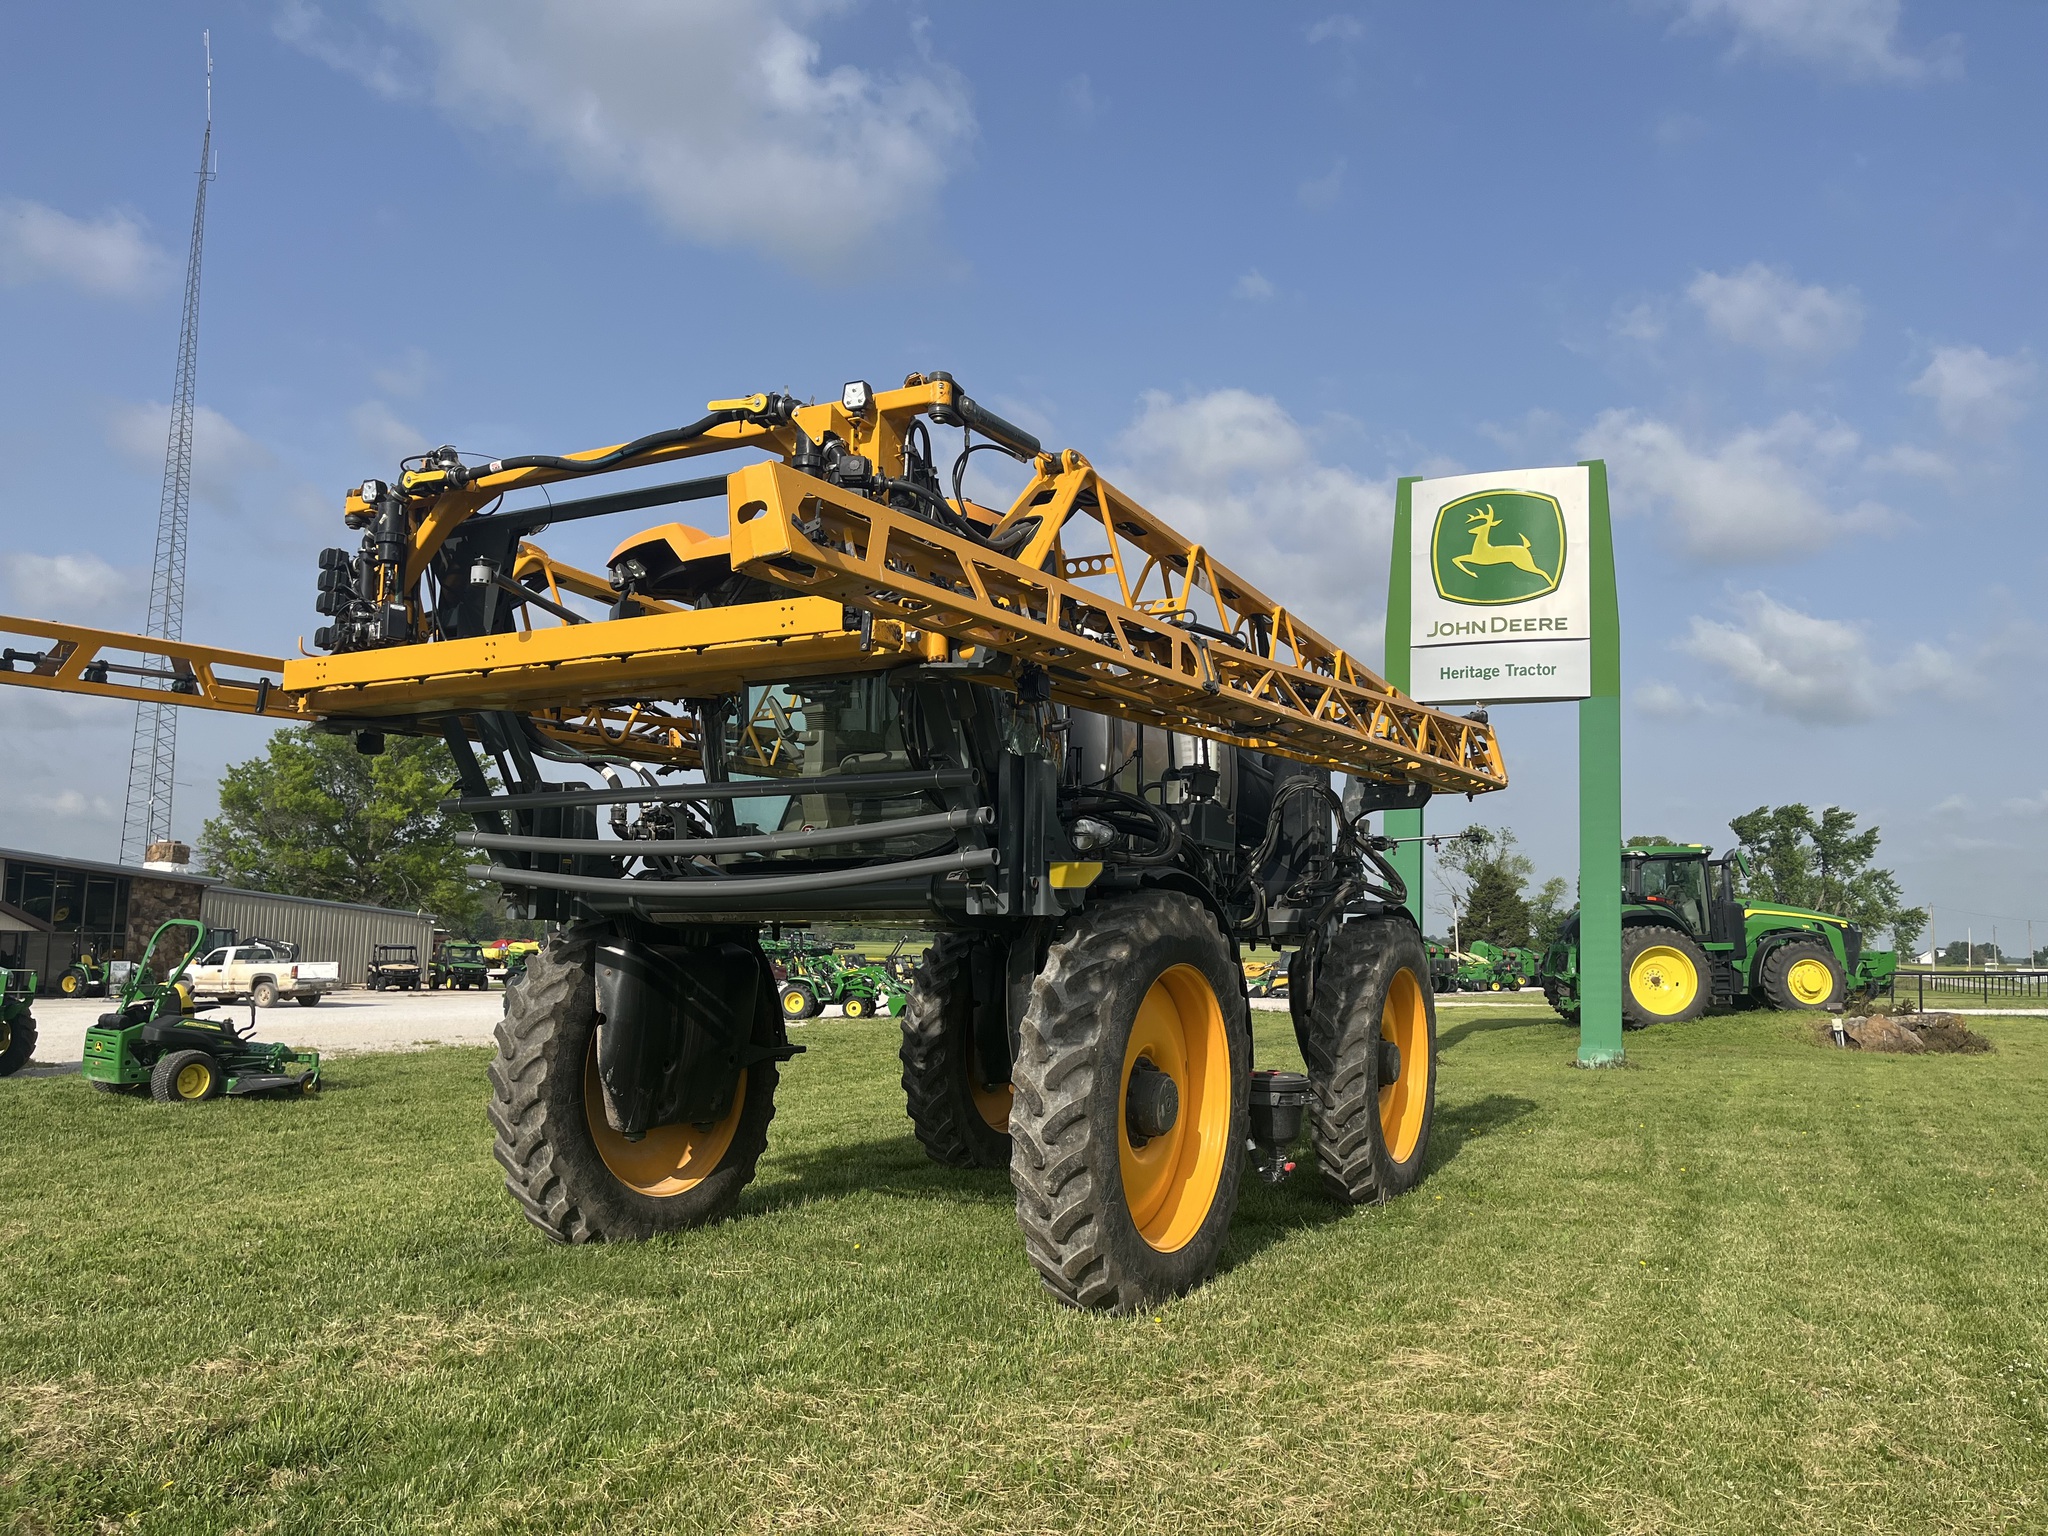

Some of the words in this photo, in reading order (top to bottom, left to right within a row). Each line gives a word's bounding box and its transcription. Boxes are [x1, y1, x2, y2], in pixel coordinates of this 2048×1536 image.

[1426, 621, 1486, 638] JOHN
[1490, 616, 1568, 633] DEERE
[1440, 665, 1500, 681] Heritage
[1505, 663, 1557, 677] Tractor
